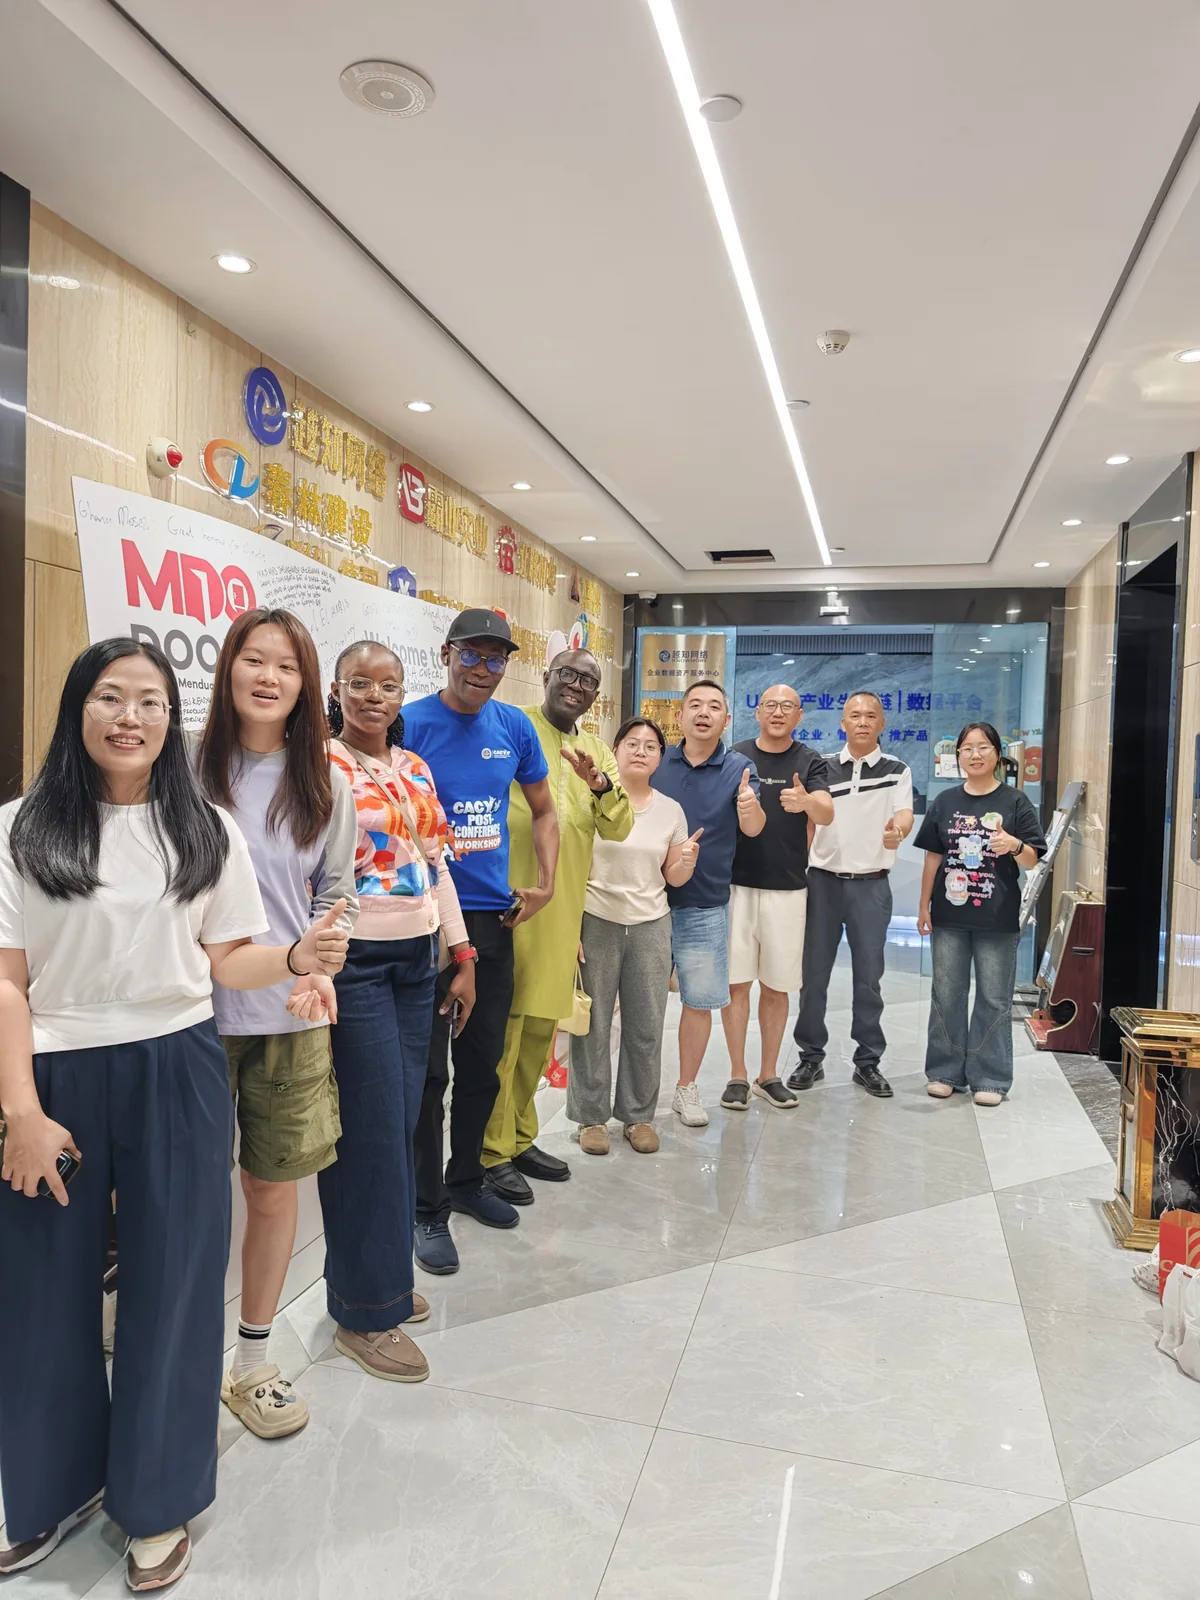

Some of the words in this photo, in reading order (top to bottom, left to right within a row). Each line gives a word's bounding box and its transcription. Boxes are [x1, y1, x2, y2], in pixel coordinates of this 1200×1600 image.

[288, 398, 388, 502] 越知网络
[121, 538, 257, 627] MDO
[363, 629, 428, 667] Wlcome
[672, 650, 708, 659] 越知网络
[647, 669, 720, 677] 企业数据资产服务中心
[889, 729, 928, 741] 推产品
[467, 814, 494, 826] POST-
[454, 824, 500, 838] CONFERENCE
[454, 838, 500, 849] WORKSHOP
